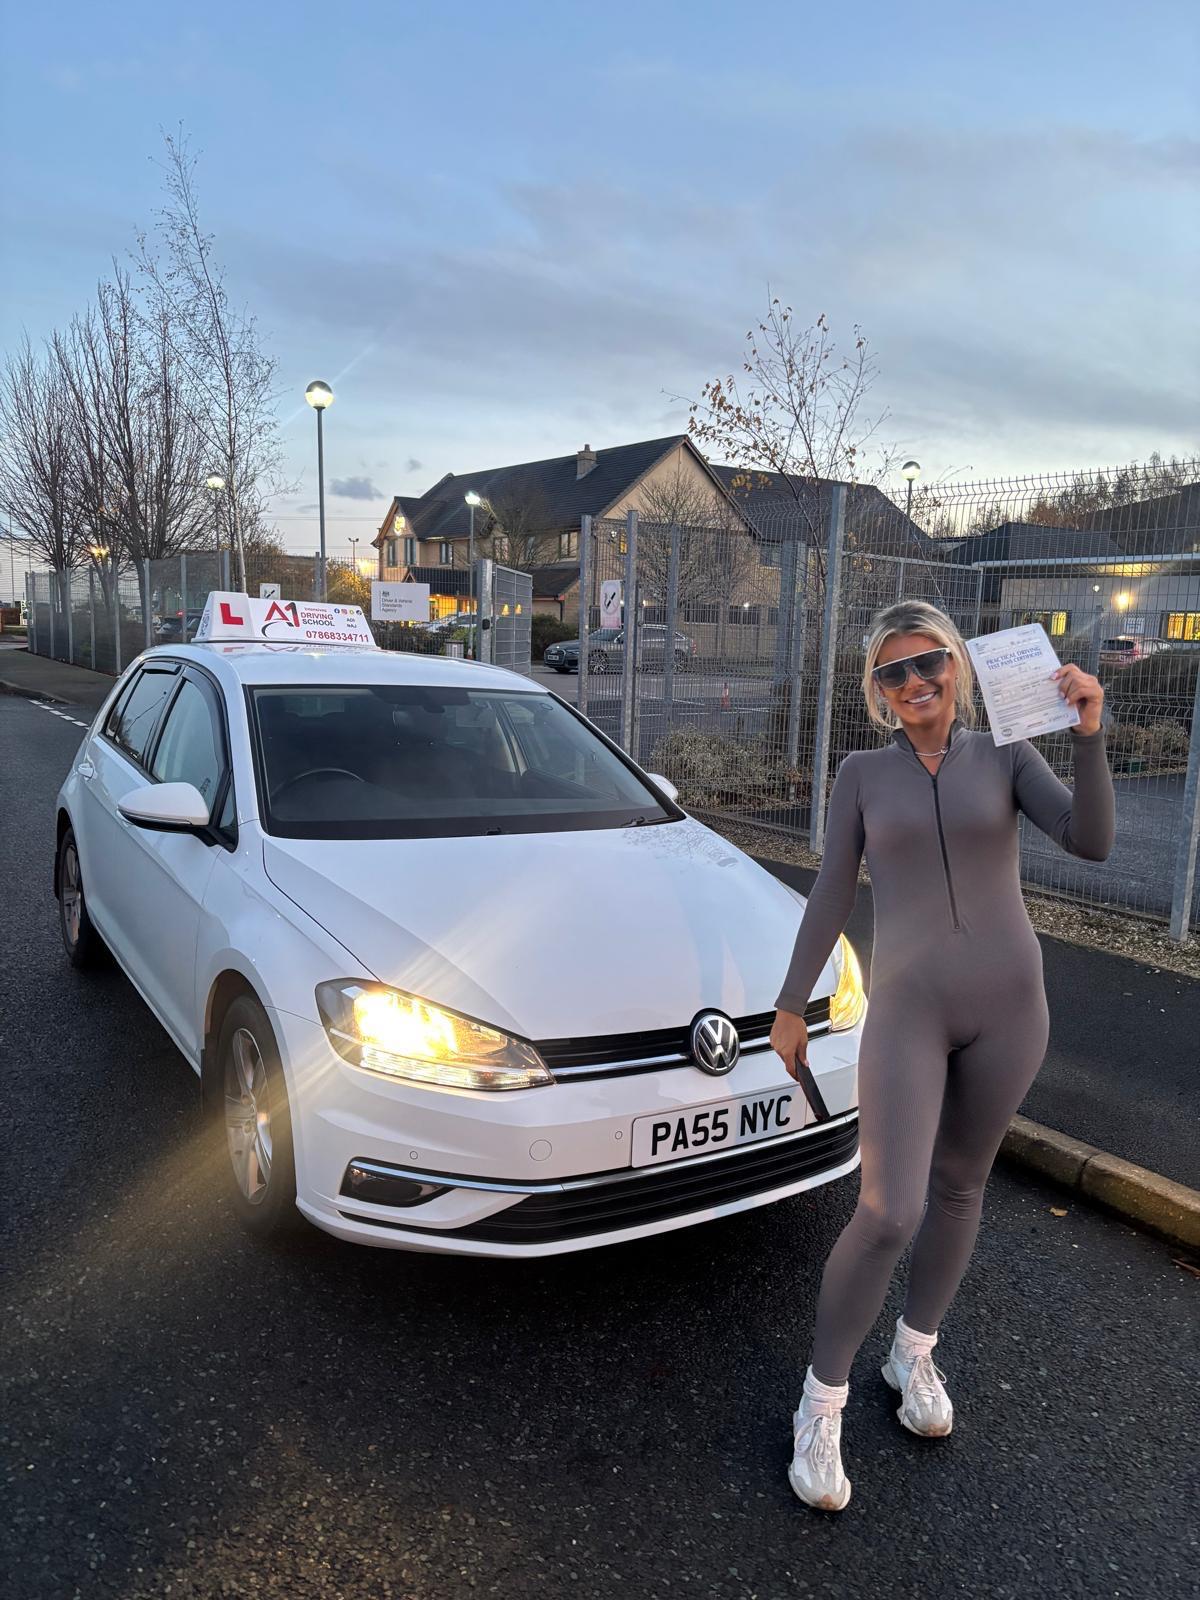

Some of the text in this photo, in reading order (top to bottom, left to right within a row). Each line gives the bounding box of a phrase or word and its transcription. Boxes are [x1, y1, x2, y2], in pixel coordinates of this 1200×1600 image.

[220, 603, 244, 625] L
[264, 601, 300, 628] A1
[300, 612, 334, 620] DRIVING
[302, 619, 335, 627] SCHOOL
[306, 630, 369, 642] 07868334711
[651, 1095, 793, 1156] PA55 NYC
